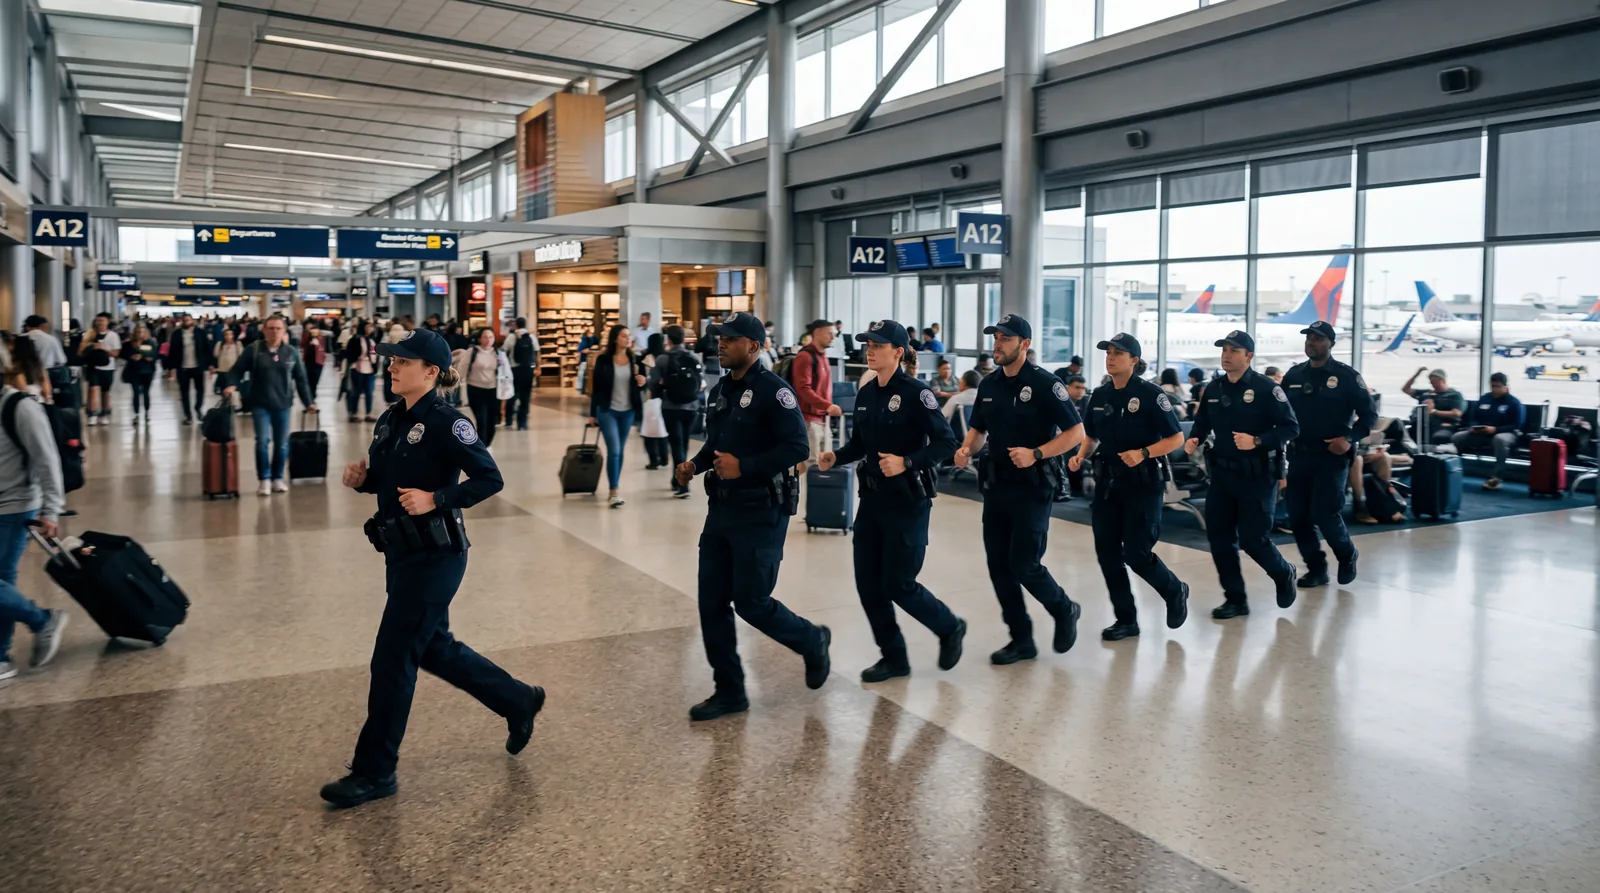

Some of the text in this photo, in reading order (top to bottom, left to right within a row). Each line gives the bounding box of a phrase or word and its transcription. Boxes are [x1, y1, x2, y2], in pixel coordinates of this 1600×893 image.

[35, 218, 84, 238] A12
[963, 223, 1002, 244] A12
[852, 247, 885, 264] A12
